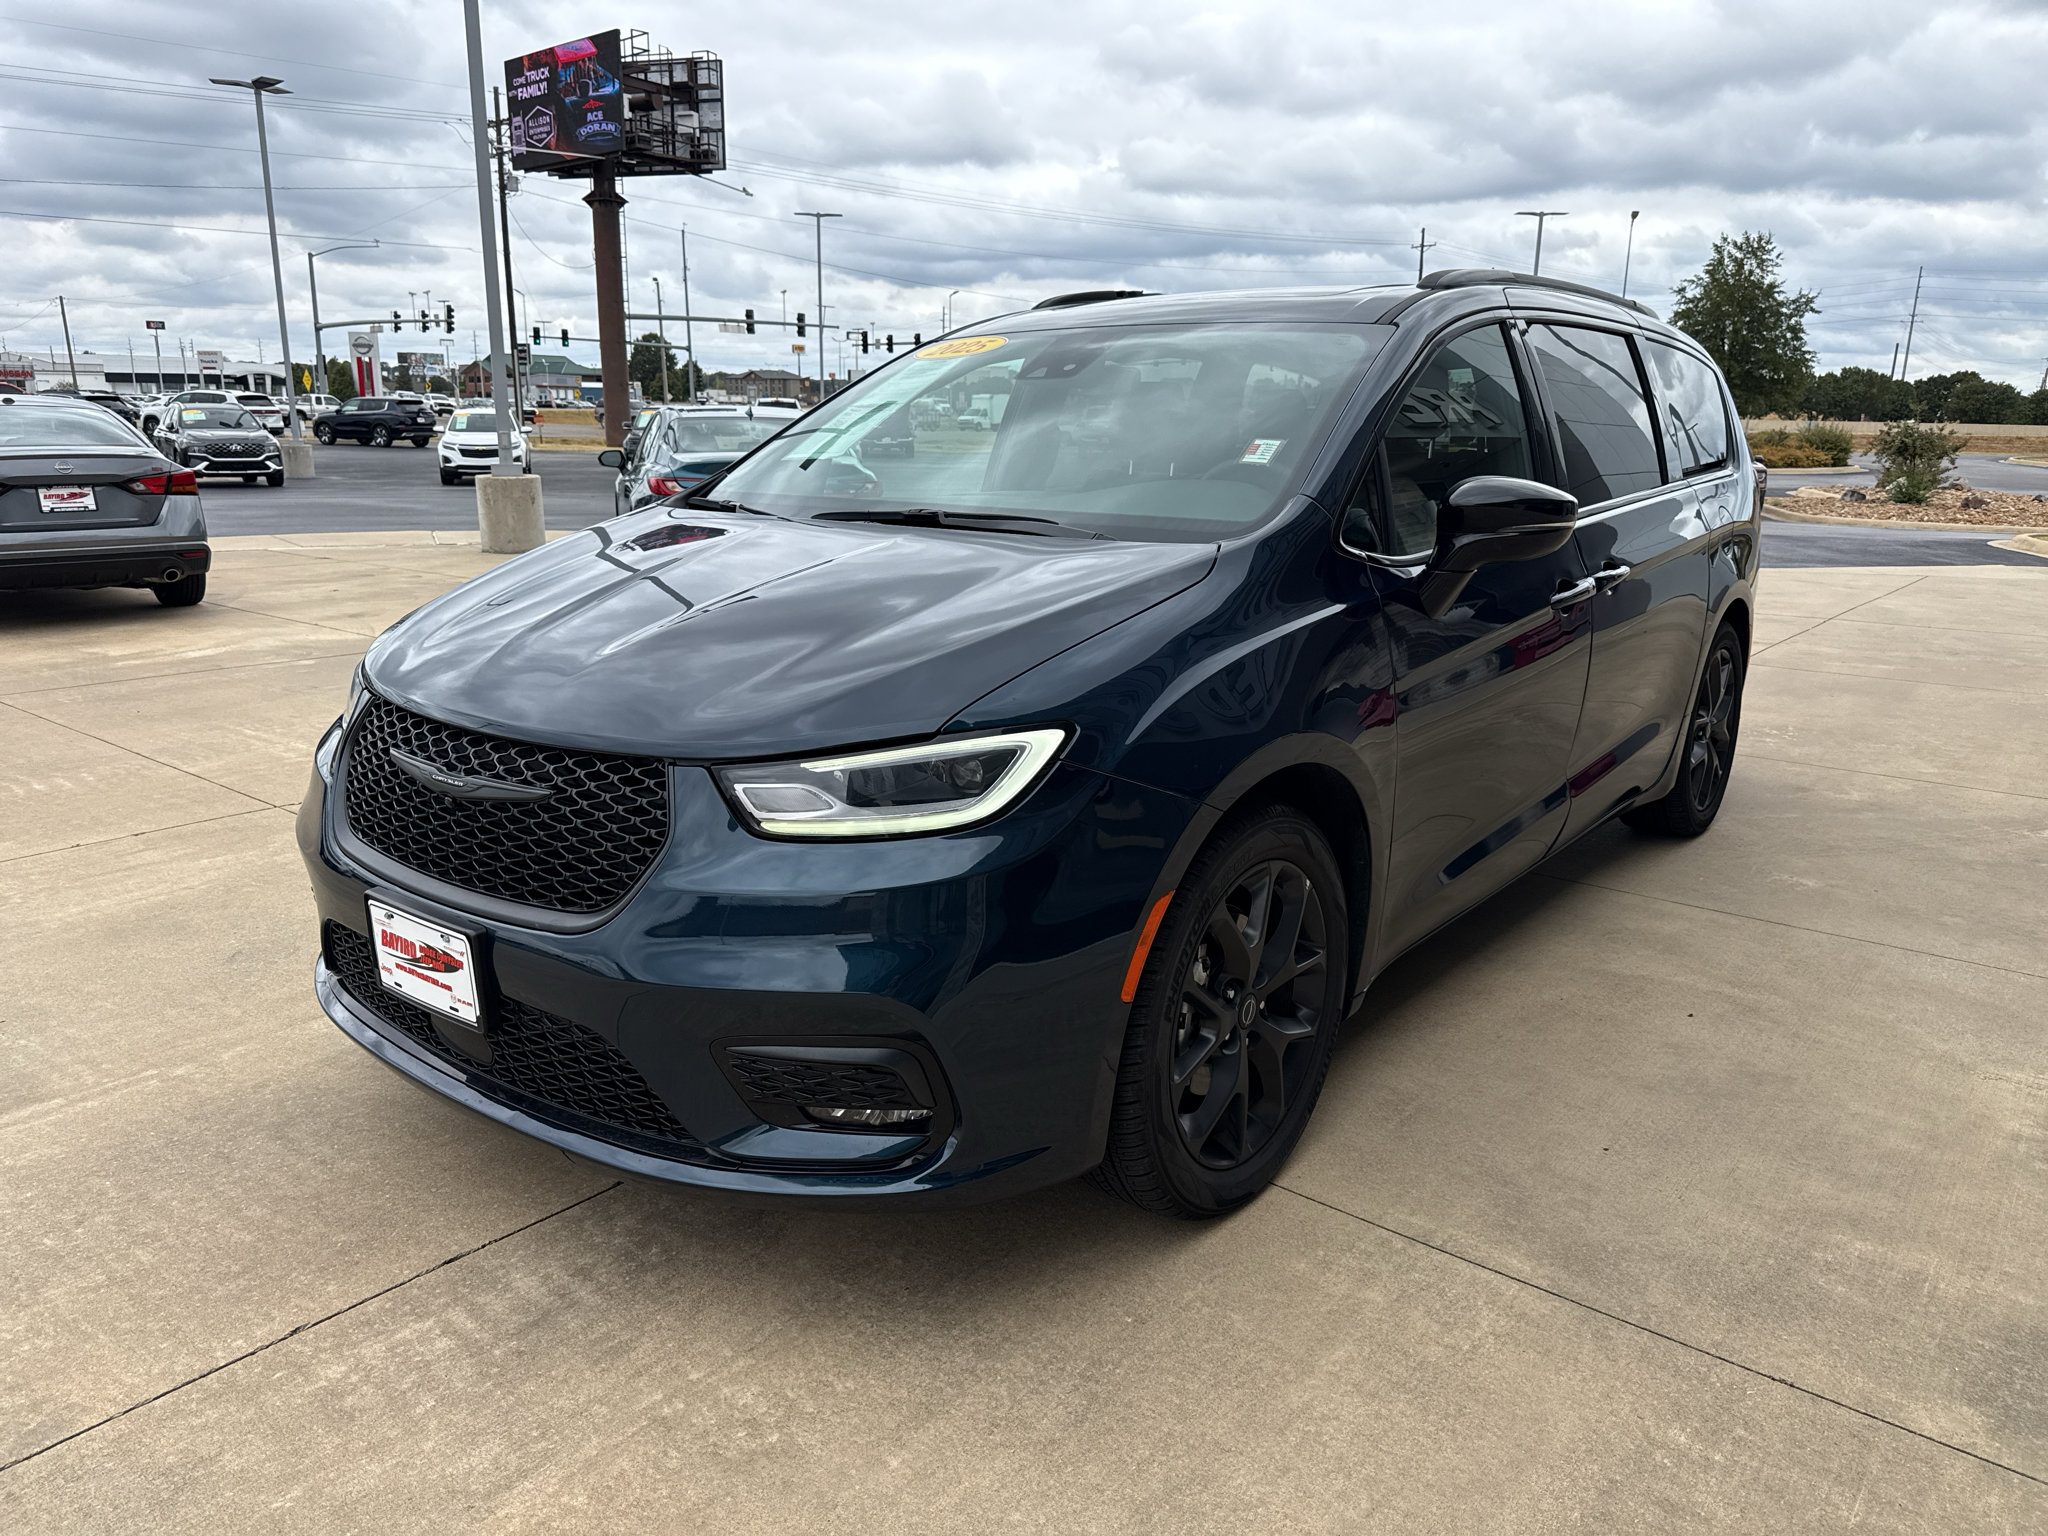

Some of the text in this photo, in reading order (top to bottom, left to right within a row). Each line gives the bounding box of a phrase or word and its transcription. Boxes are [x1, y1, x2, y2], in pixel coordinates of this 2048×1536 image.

[526, 66, 550, 83] TRUCK
[517, 81, 548, 101] FAMILY!
[528, 115, 550, 126] ALLISON
[587, 110, 604, 122] ACE
[580, 122, 616, 135] DORAN
[922, 339, 999, 357] 2025
[0, 369, 33, 379] NISSAN
[432, 774, 464, 787] CHRYSLER
[381, 928, 417, 958] BAYIRD
[437, 952, 464, 970] CHRYSLER
